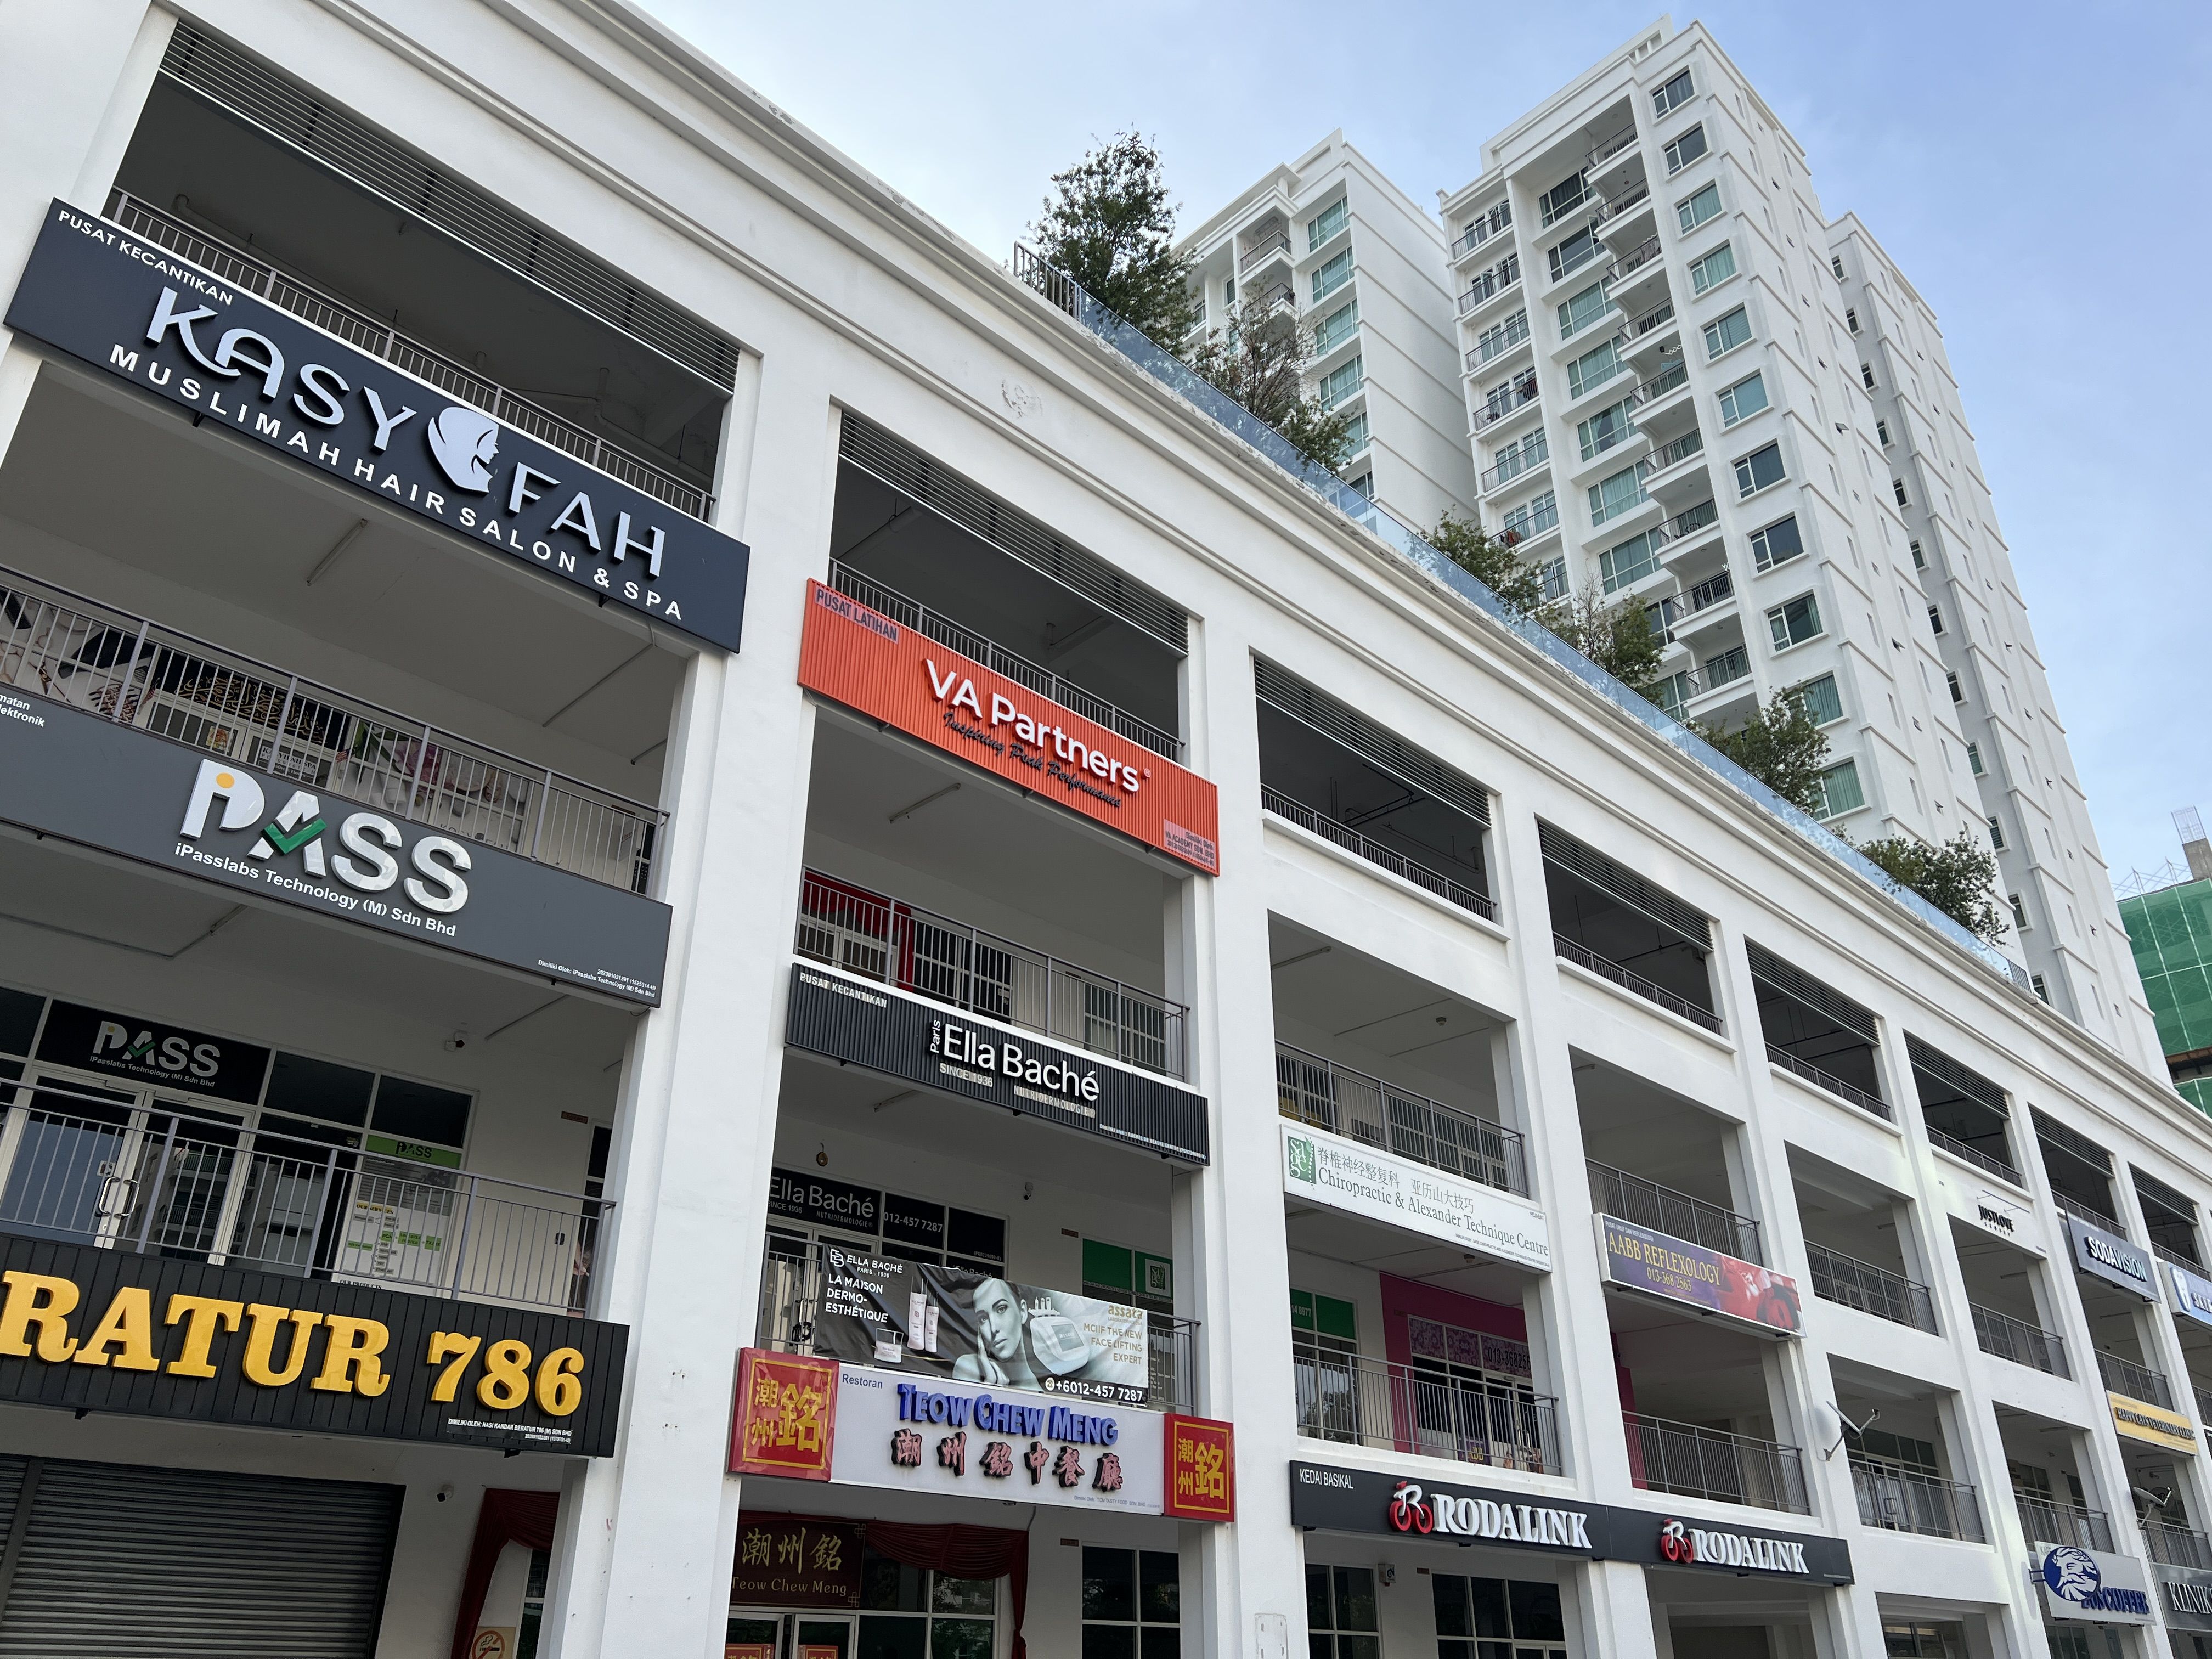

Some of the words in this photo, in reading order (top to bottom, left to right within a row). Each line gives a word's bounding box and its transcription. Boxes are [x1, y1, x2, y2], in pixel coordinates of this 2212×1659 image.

[58, 211, 116, 246] PUSAT
[119, 240, 233, 305] KECANTIKAN
[110, 343, 340, 466] MUSLIMAH
[354, 458, 445, 514] HAIR
[460, 506, 576, 573] SALON
[593, 567, 610, 588] &
[623, 580, 681, 620] SPA
[506, 462, 665, 578] FAH
[816, 589, 851, 617] PUSAT
[854, 608, 897, 641] LATIHAN
[923, 659, 983, 720] VA
[990, 692, 1139, 793] Partners
[944, 711, 1005, 756] Inspiring
[1010, 743, 1043, 772] Peak
[1165, 831, 1171, 839] VA
[1172, 834, 1193, 849] ACADEMY
[1205, 850, 1214, 859] BHD
[175, 843, 259, 879] iPasslabs
[265, 869, 358, 910] Technology
[363, 899, 387, 916] (M)
[391, 907, 421, 927] Sdn
[425, 917, 456, 936] Bhd
[538, 960, 557, 970] Dimiliki
[558, 965, 572, 974] Oleh:
[572, 969, 596, 981] iPasslabs
[597, 976, 625, 990] Technology
[799, 972, 830, 990] PUSAT
[832, 981, 887, 1008] KECANTIKAN
[930, 1020, 941, 1054] Paris
[89, 1056, 126, 1069] iPasslabs
[128, 1063, 171, 1080] Technology
[171, 1072, 183, 1081] (M)
[184, 1075, 198, 1084] Sdn
[200, 1079, 215, 1087] Bhd
[940, 1063, 969, 1081] SINCE
[973, 1073, 993, 1088] 1936
[944, 1023, 995, 1070] Ella
[1003, 1042, 1099, 1101] Baché
[788, 1205, 803, 1214] 1936
[809, 1185, 874, 1218] Baché
[1318, 1167, 1392, 1206] Chiropractic
[1395, 1192, 1404, 1209] &
[1408, 1197, 1461, 1227] Alexander
[1463, 1214, 1515, 1246] Technique
[1517, 1233, 1549, 1256] Centre
[1411, 1179, 1474, 1214] 亚历山大技巧
[884, 1211, 920, 1228] 012-457
[921, 1220, 943, 1233] 7287
[1530, 1211, 1544, 1221] PEJABAT
[847, 1255, 868, 1267] ELLA
[872, 1260, 903, 1273] BACHÉ
[857, 1267, 872, 1275] PARIS
[1609, 1232, 1641, 1261] AABB
[1643, 1243, 1720, 1286] REFLEXOLOGY
[2086, 1236, 2147, 1282] SODAVISION
[828, 1273, 842, 1285] LA
[845, 1277, 883, 1294] MAISON
[1647, 1267, 1674, 1286] 013-368
[1675, 1276, 1692, 1292] 2563
[827, 1288, 868, 1304] DERMO-
[825, 1302, 889, 1323] ESTHÉTIQUE
[1108, 1305, 1142, 1320] assata
[0, 1271, 391, 1397] RATUR
[427, 1332, 585, 1417] 786
[1091, 1337, 1111, 1347] FACE
[1113, 1340, 1142, 1352] LIFTING
[1108, 1327, 1123, 1336] THE
[1125, 1330, 1142, 1340] NEW
[1113, 1353, 1142, 1365] EXPERT
[842, 1373, 883, 1389] Restoran
[1056, 1380, 1115, 1398] +6012-457
[1118, 1387, 1143, 1402] 7287
[448, 1418, 466, 1426] DIMILIKI
[494, 1422, 514, 1430] KANDAR
[897, 1383, 973, 1427] TEOW
[973, 1393, 1045, 1437] CHEW
[1048, 1406, 1119, 1446] MENG
[1300, 1469, 1322, 1485] KEDAI
[1323, 1472, 1353, 1489] BASIKAL
[1430, 1493, 1593, 1549] RODALINK
[1689, 1528, 1810, 1575] RODALINK
[771, 1578, 808, 1592] Chew
[812, 1580, 848, 1598] Meng
